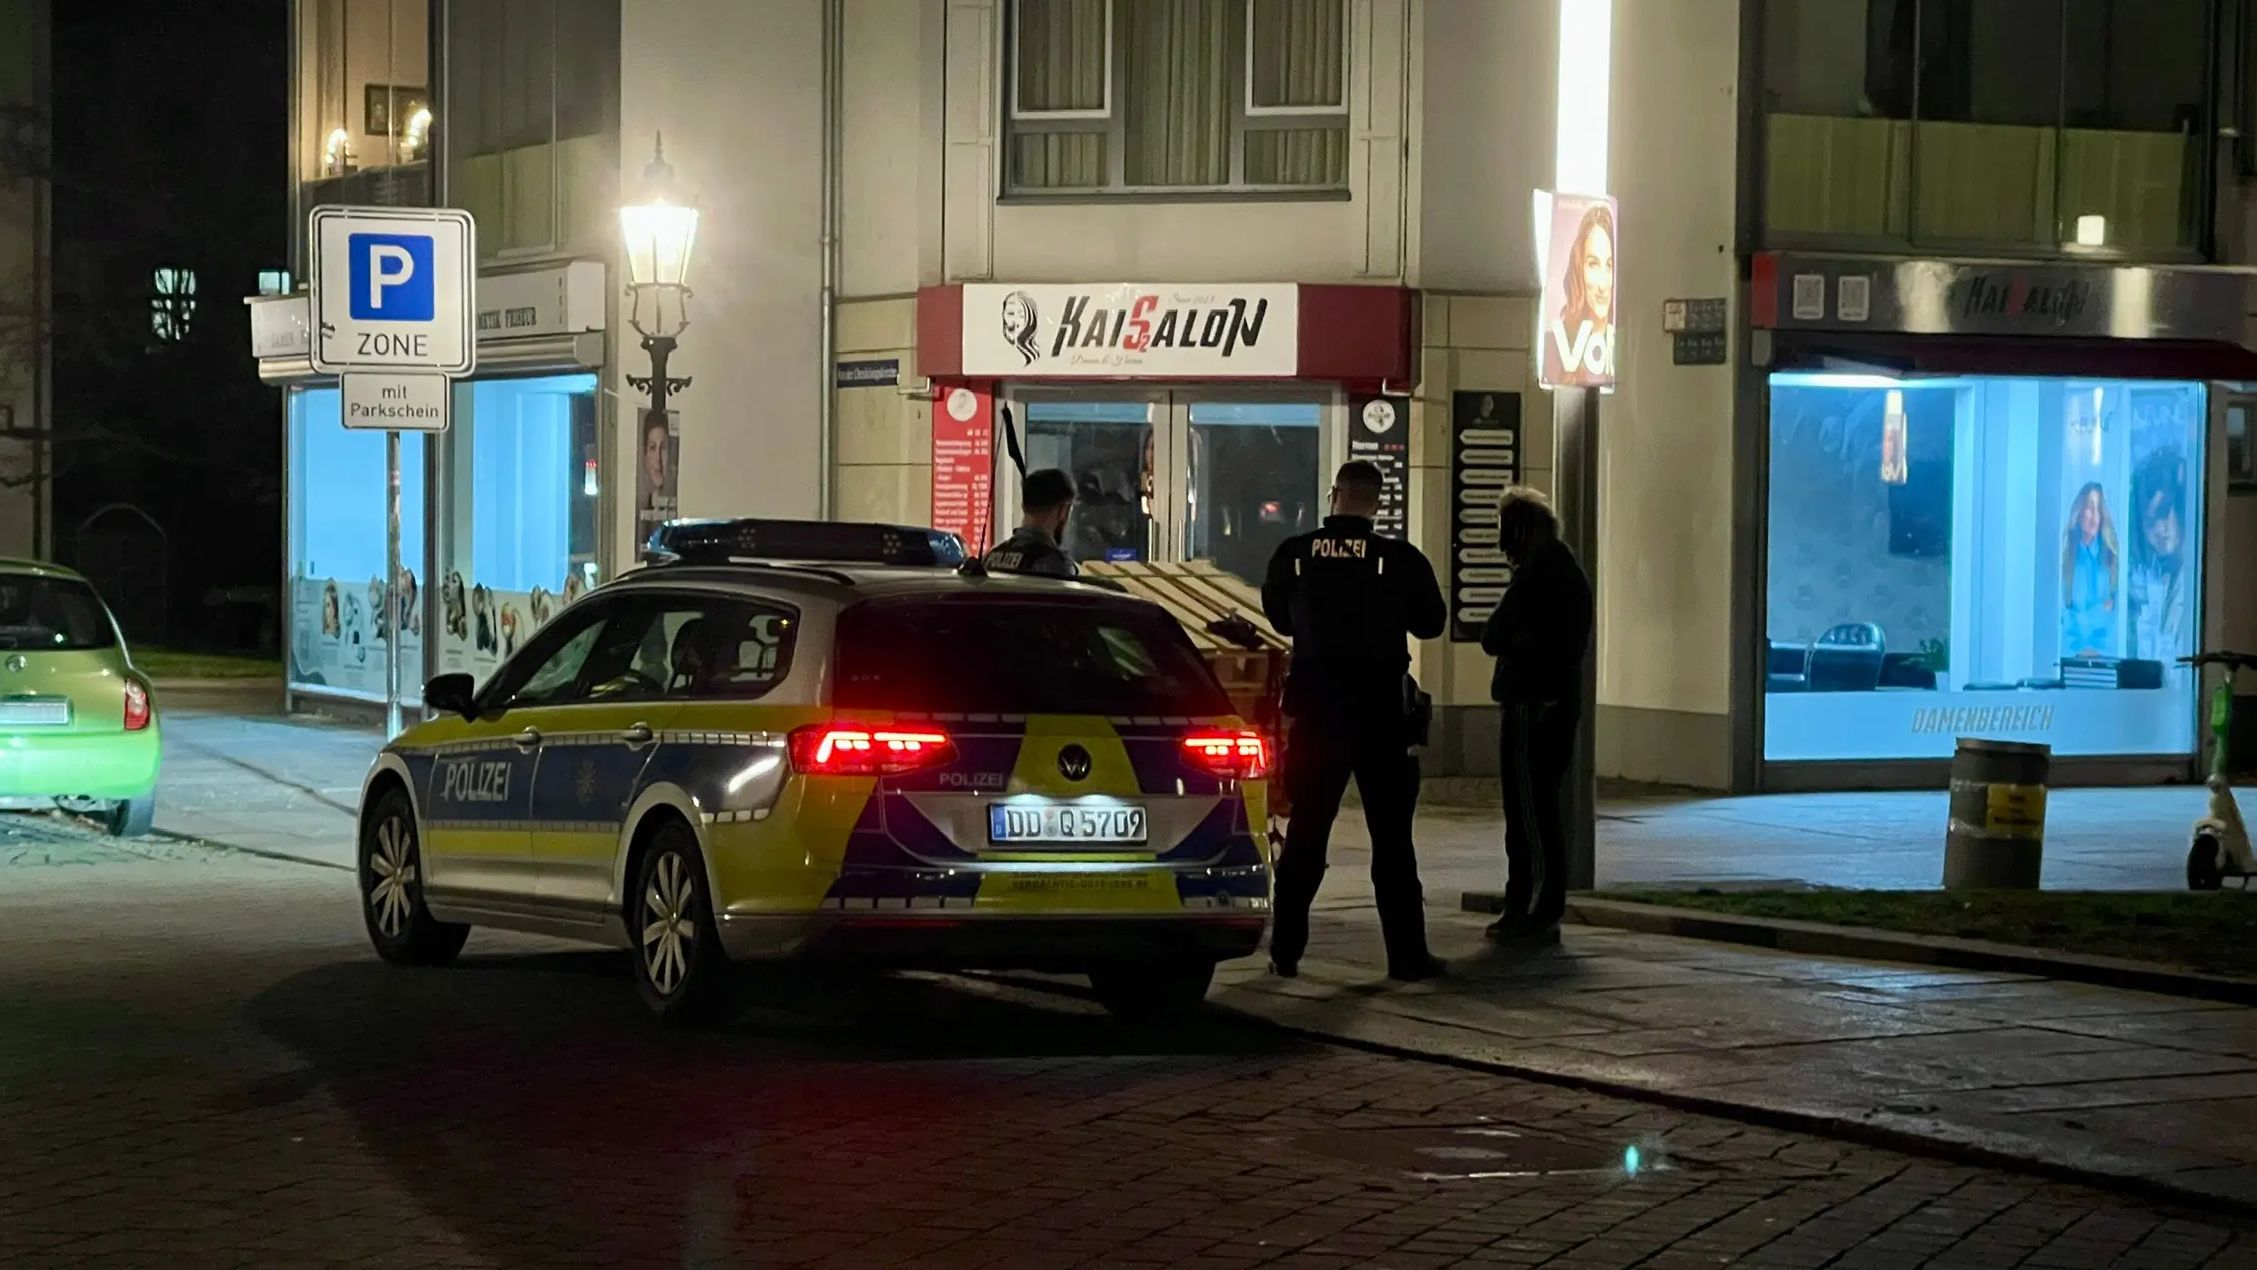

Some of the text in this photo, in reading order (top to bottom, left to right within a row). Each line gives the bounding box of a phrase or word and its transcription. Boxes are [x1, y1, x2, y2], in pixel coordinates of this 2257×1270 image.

[369, 244, 414, 309] P
[357, 332, 428, 357] ZONE
[381, 384, 407, 400] mit
[350, 403, 439, 419] Parkschein
[1312, 538, 1366, 558] POLIZEI
[1912, 705, 2055, 733] DAMENBEREICH
[444, 761, 512, 801] POLIZEI
[939, 772, 1003, 786] POLIZEI
[1007, 810, 1041, 837] DD
[1060, 810, 1075, 837] Q
[1081, 810, 1144, 838] 5709
